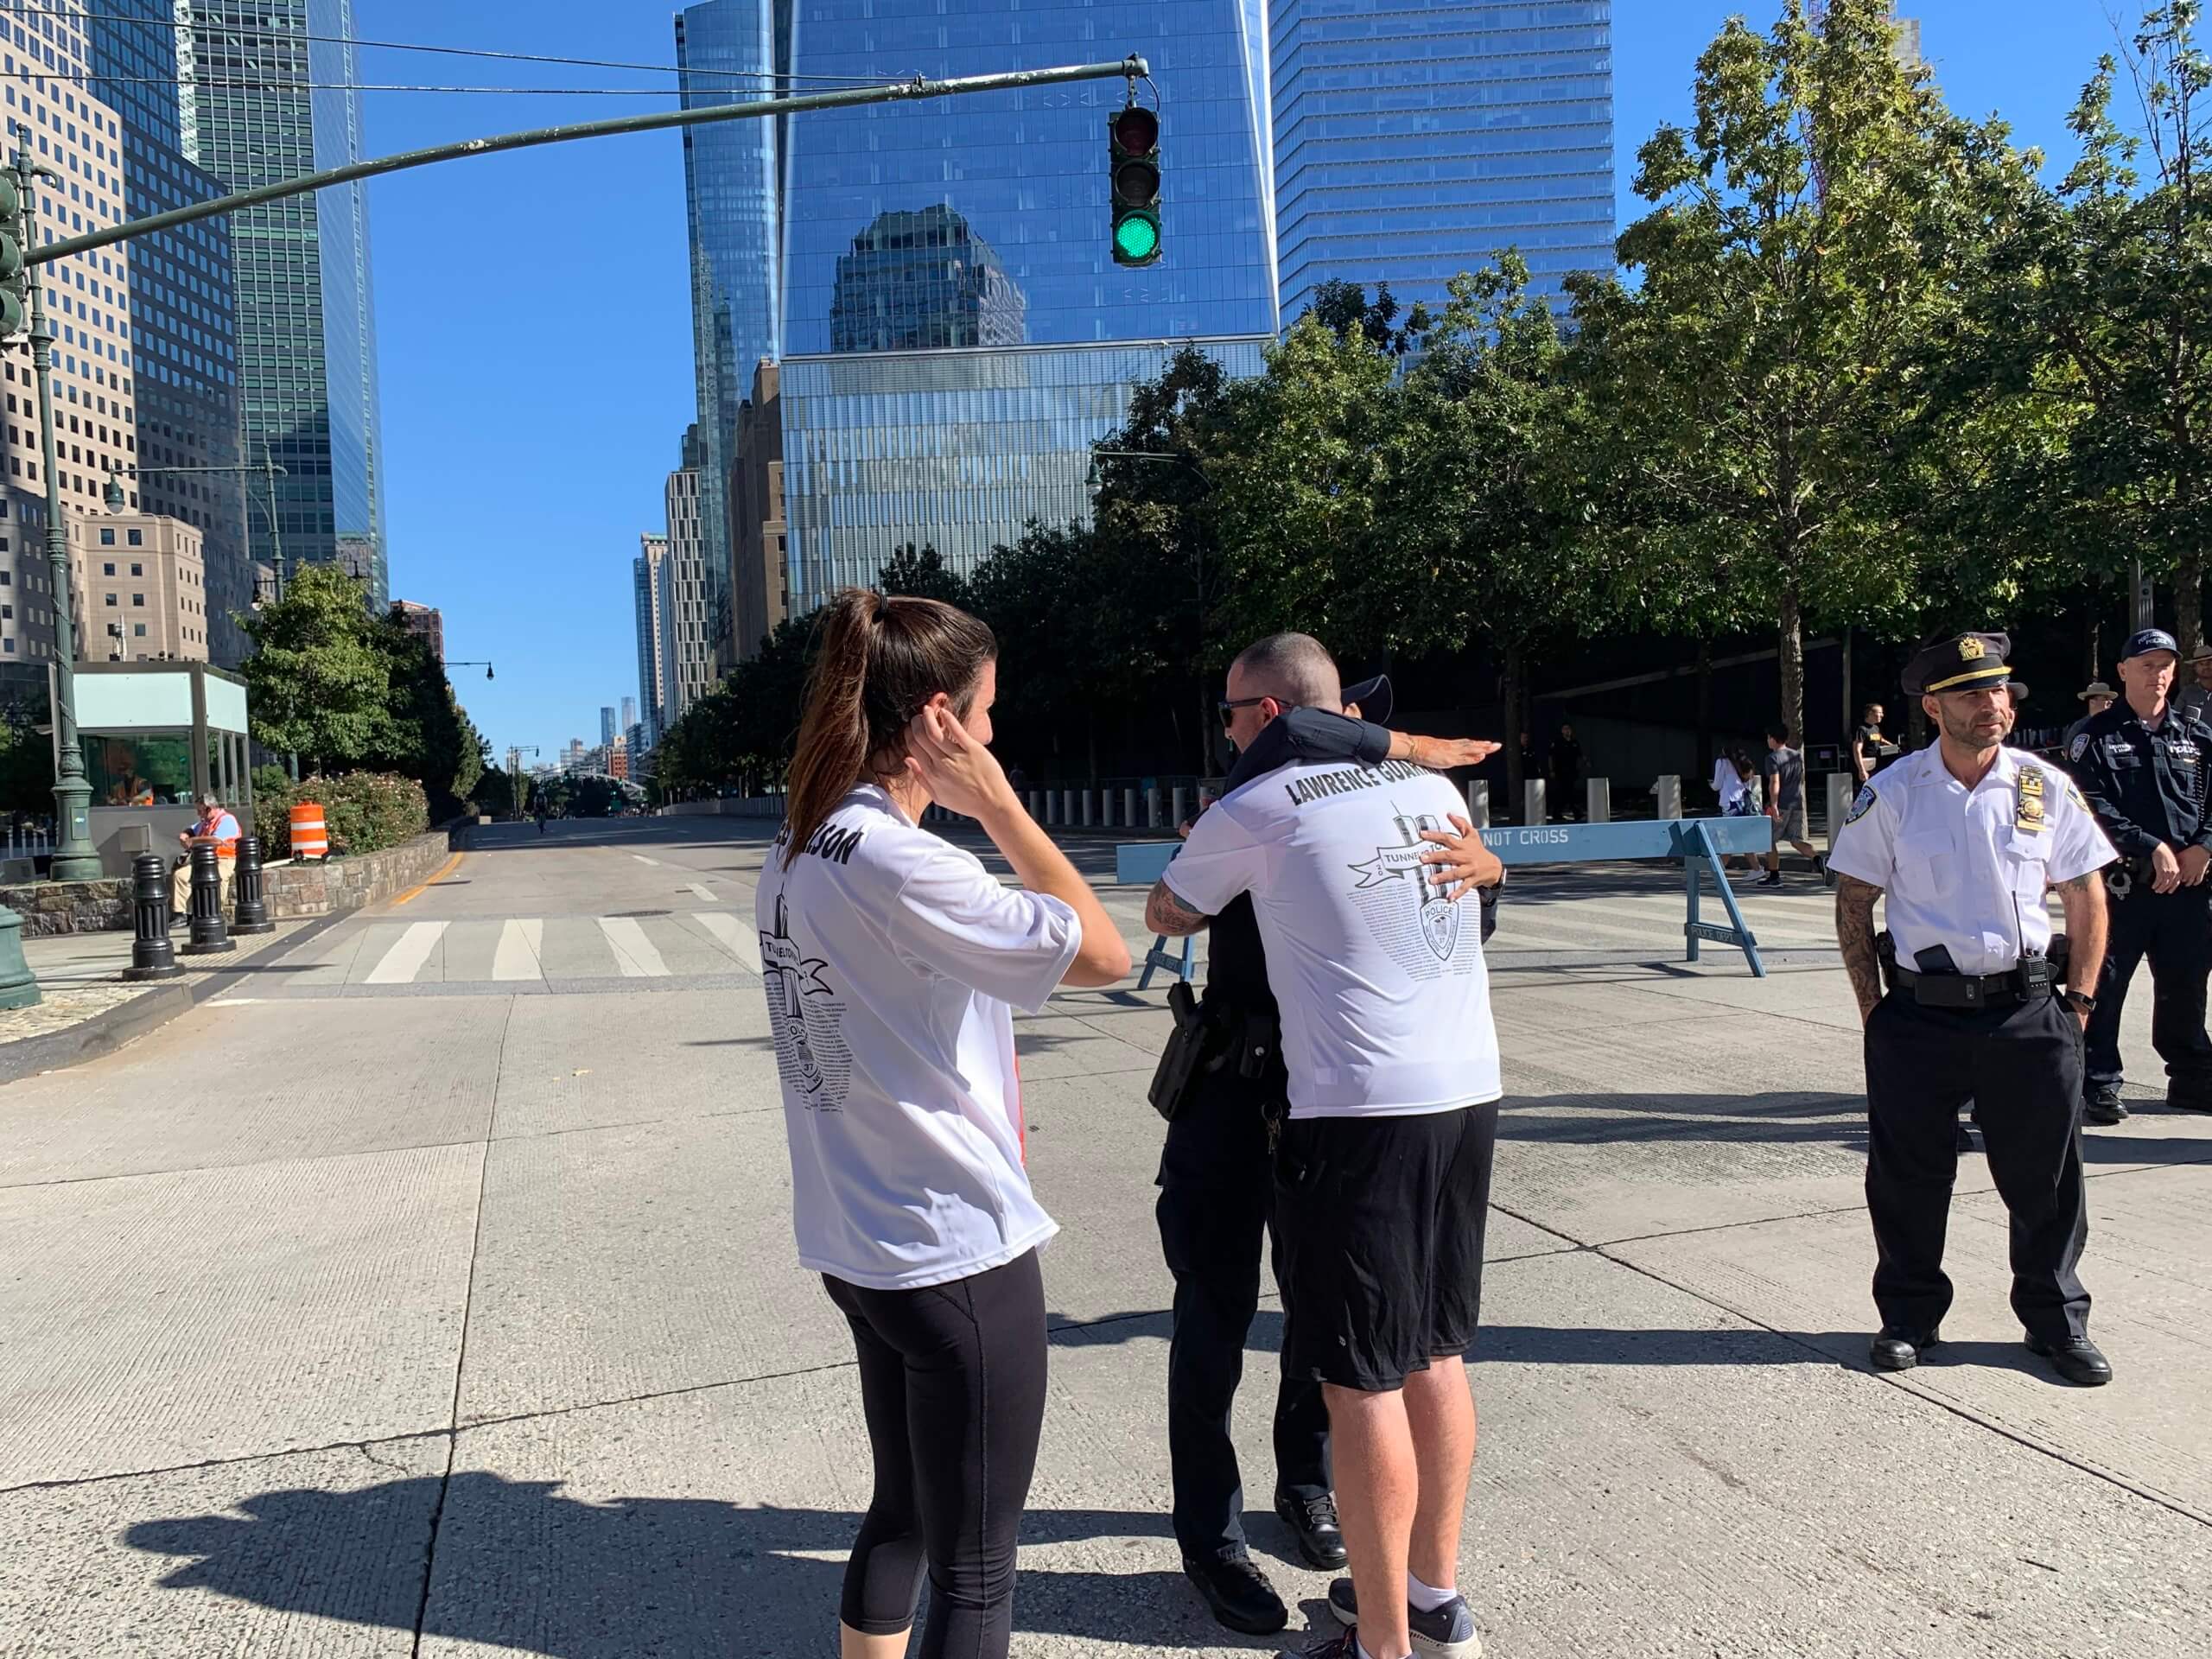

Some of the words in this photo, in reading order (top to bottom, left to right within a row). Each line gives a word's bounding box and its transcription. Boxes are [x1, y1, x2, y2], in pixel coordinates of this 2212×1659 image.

[1284, 766, 1382, 806] LAWRENCE
[1483, 830, 1512, 847] NOT
[1520, 829, 1569, 845] CROSS
[1425, 905, 1453, 918] POLICE
[804, 1063, 814, 1071] 37
